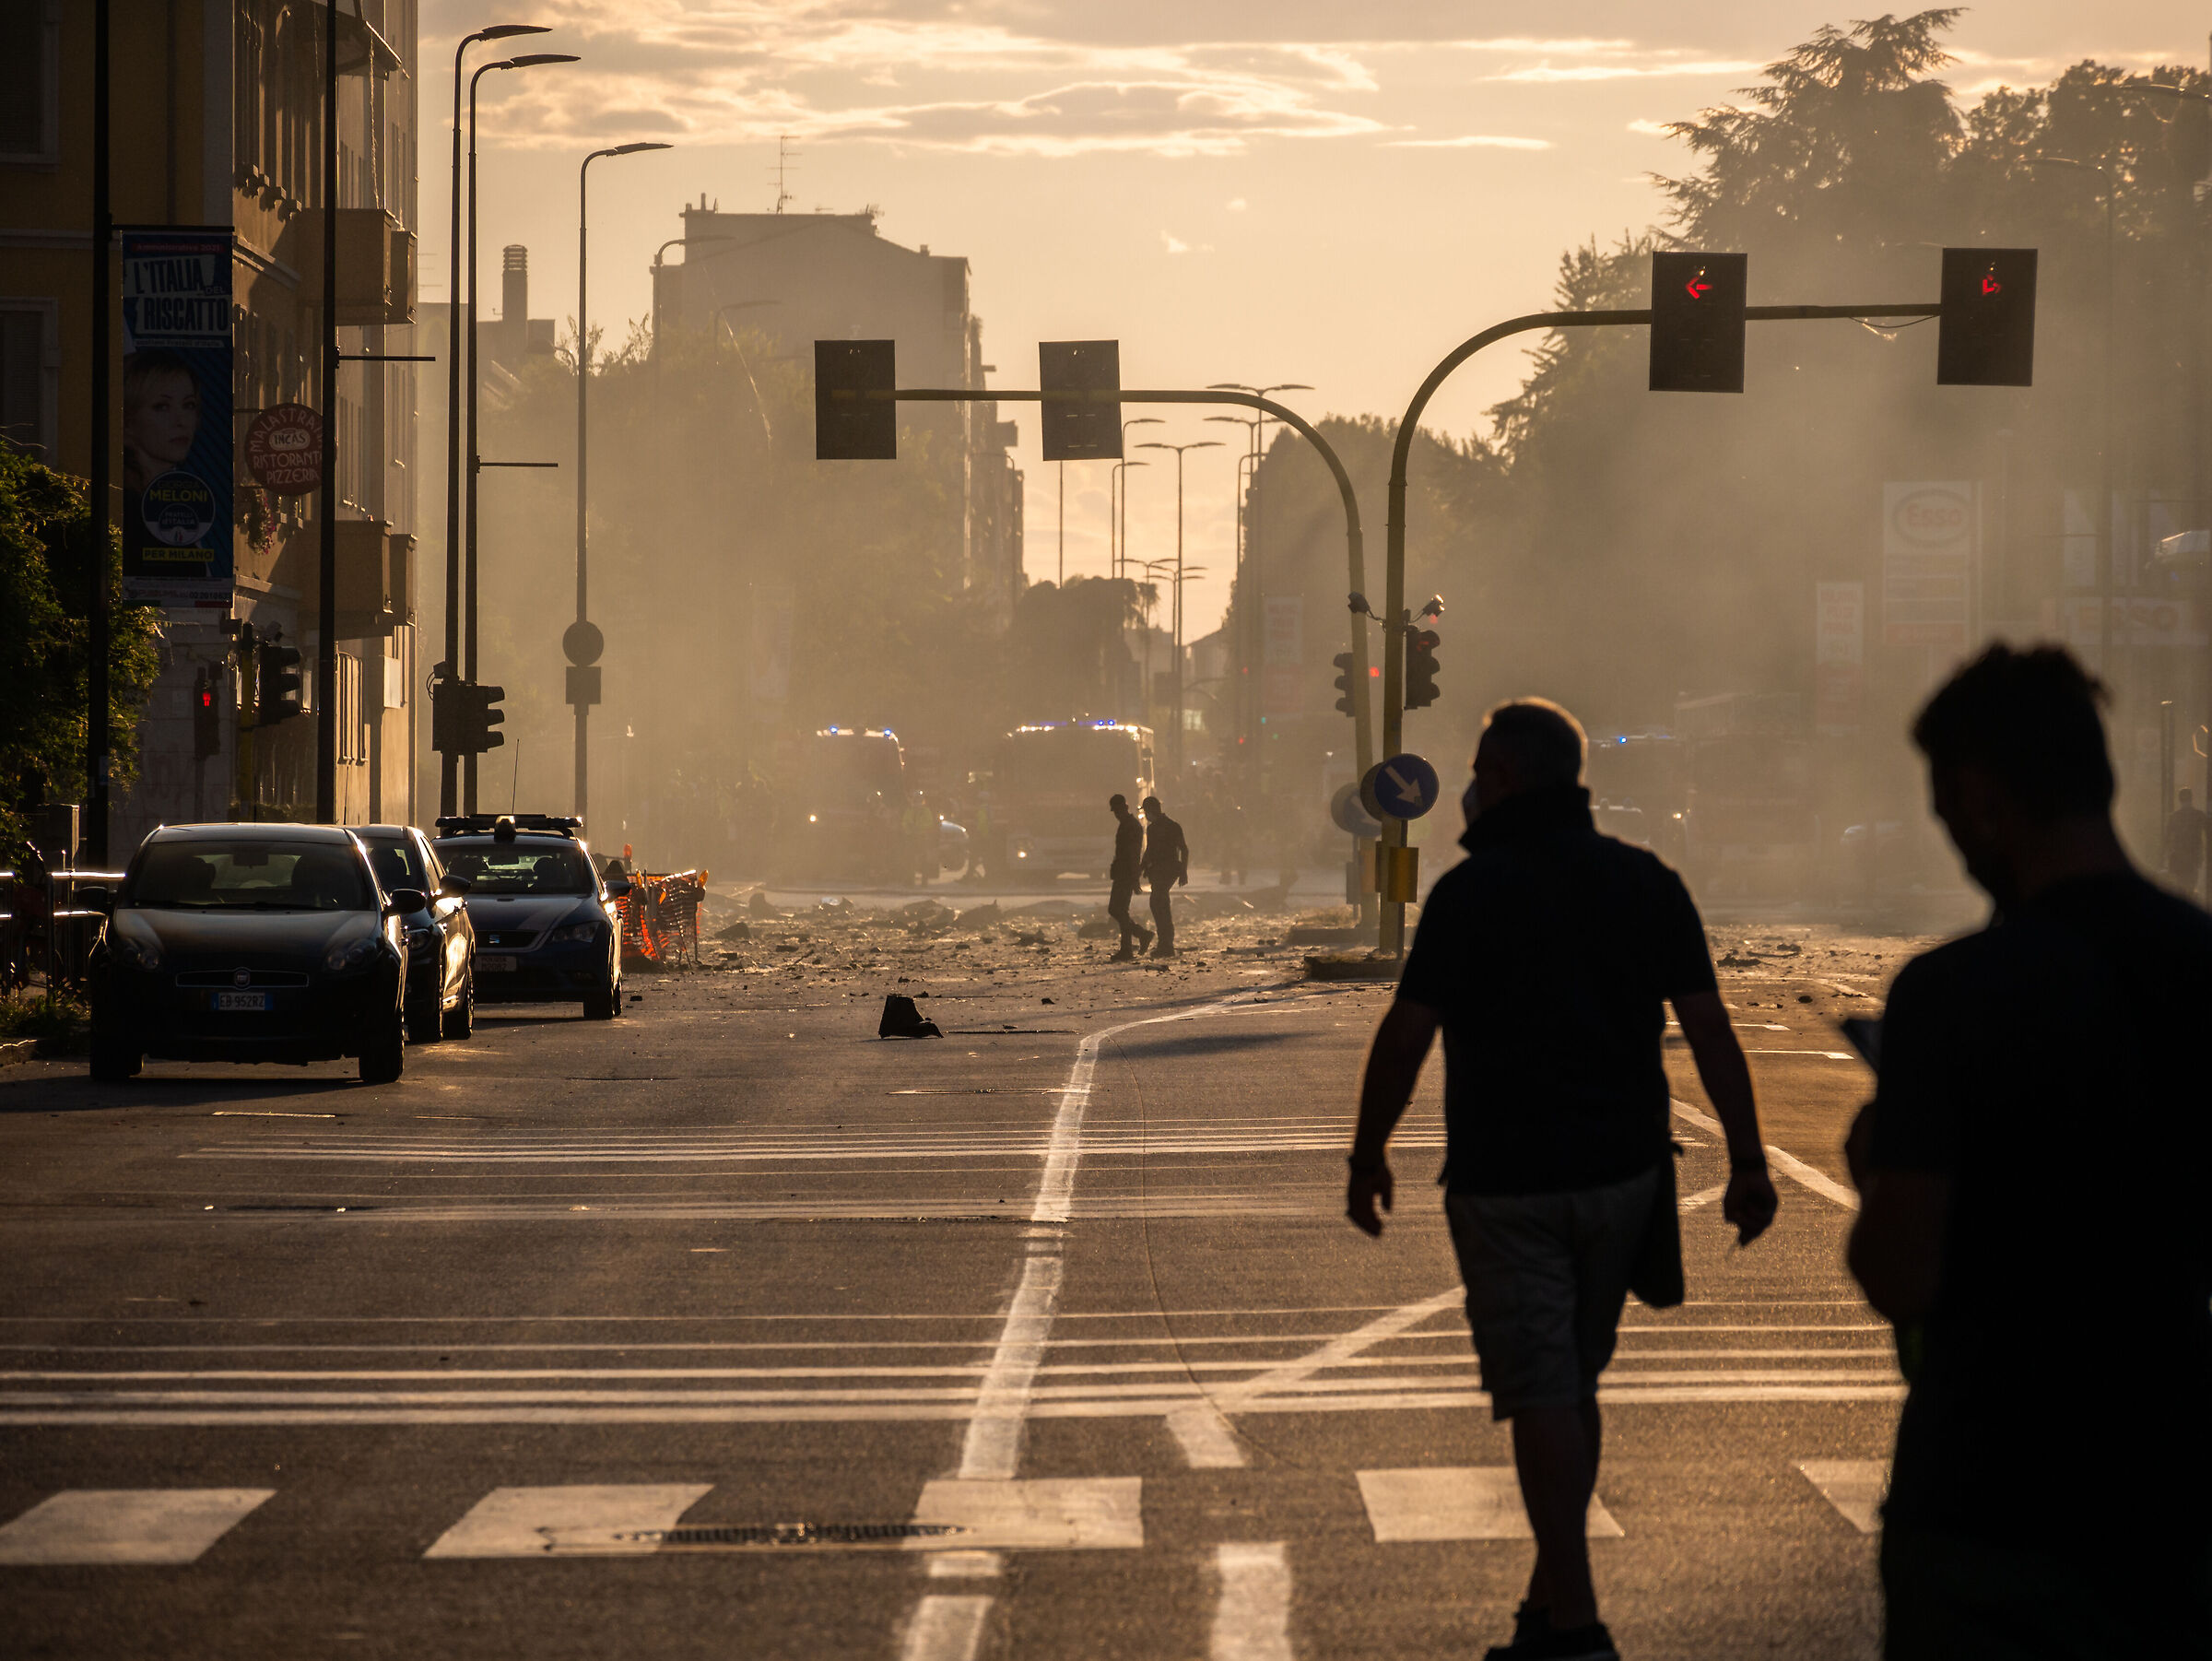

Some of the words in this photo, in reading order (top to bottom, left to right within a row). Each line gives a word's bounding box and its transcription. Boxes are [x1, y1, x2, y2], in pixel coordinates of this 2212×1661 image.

[200, 243, 220, 252] 2021
[134, 258, 204, 294] L'ITALIA
[206, 286, 228, 295] DEL
[144, 298, 229, 331] RISCATTO
[274, 434, 305, 445] INCAS
[266, 467, 319, 484] PIZZERIA
[149, 489, 207, 502] MELONI
[145, 549, 166, 558] PER
[169, 549, 213, 560] MILANO
